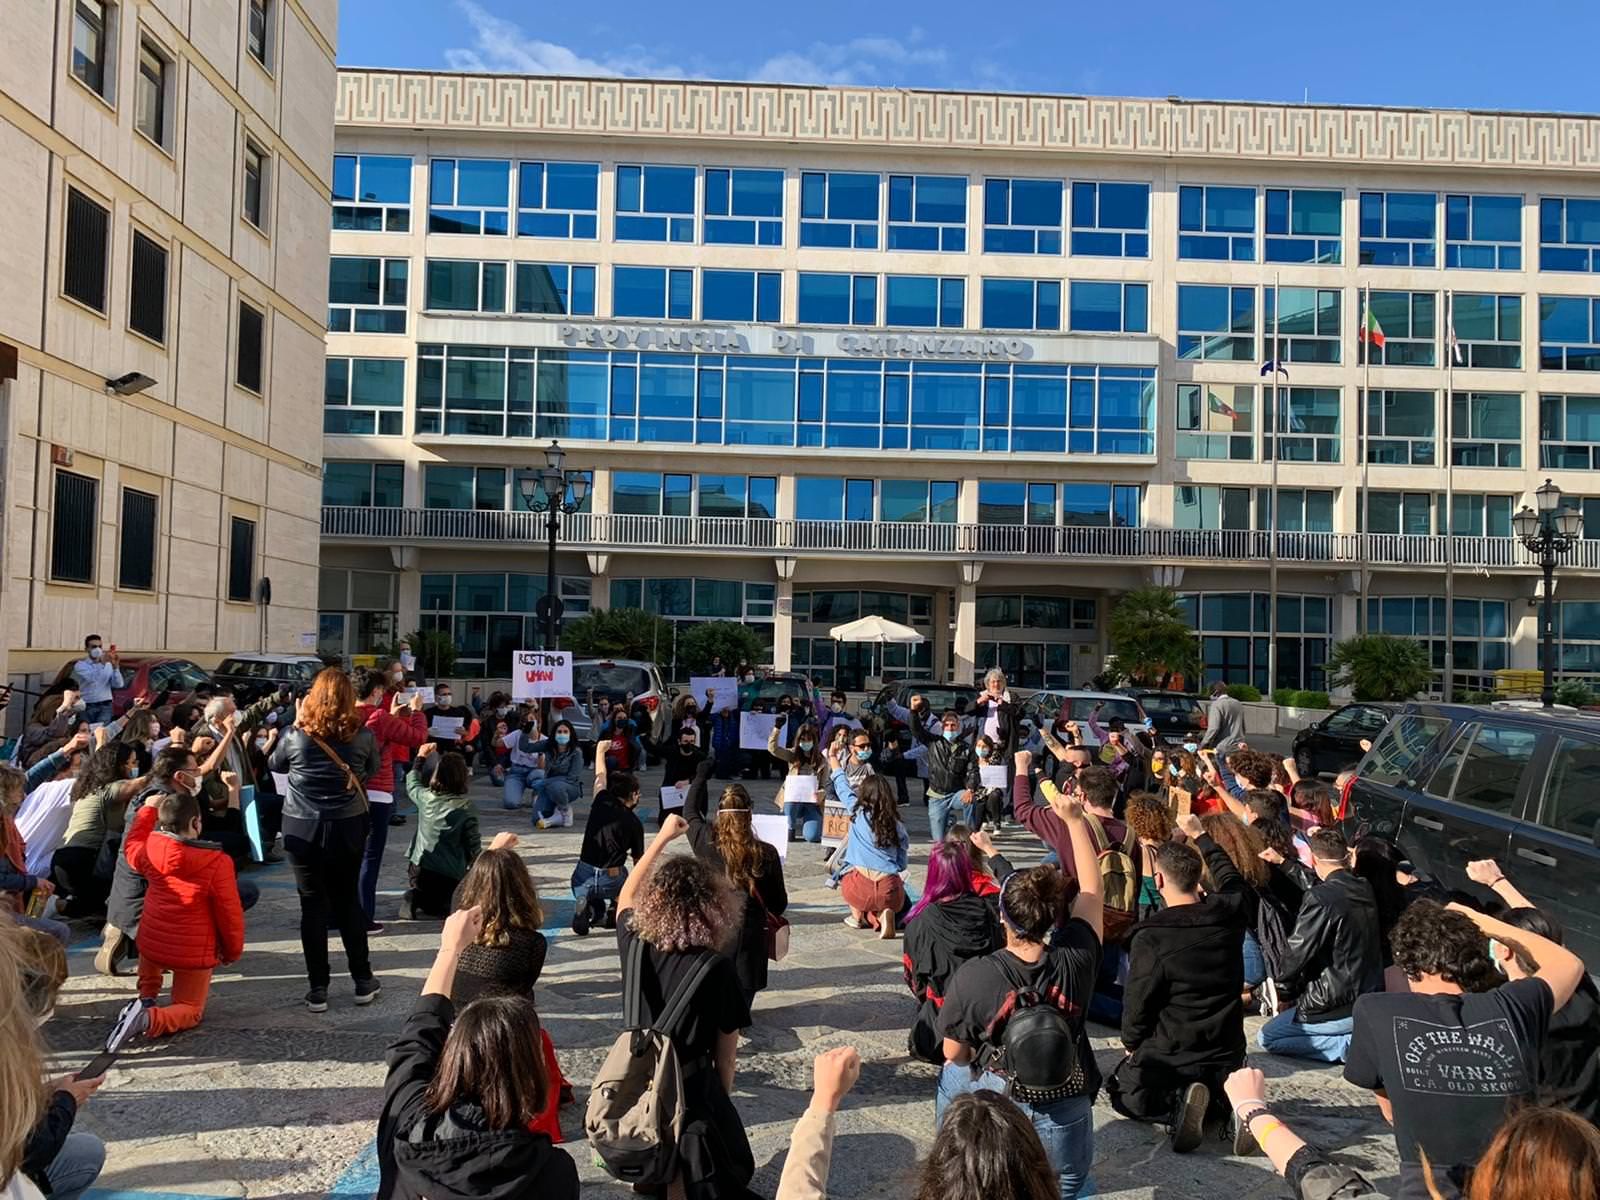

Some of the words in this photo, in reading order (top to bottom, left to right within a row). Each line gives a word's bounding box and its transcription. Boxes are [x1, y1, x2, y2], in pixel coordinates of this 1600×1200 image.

[557, 324, 740, 348] PROVINCIA
[772, 330, 802, 350] DI
[836, 333, 1024, 356] CATANZARO
[1405, 1036, 1428, 1063] OFF
[1426, 1031, 1462, 1046] THE
[1468, 1032, 1515, 1068] WALL
[1437, 1064, 1497, 1081] VANS
[1448, 1081, 1476, 1091] OLD
